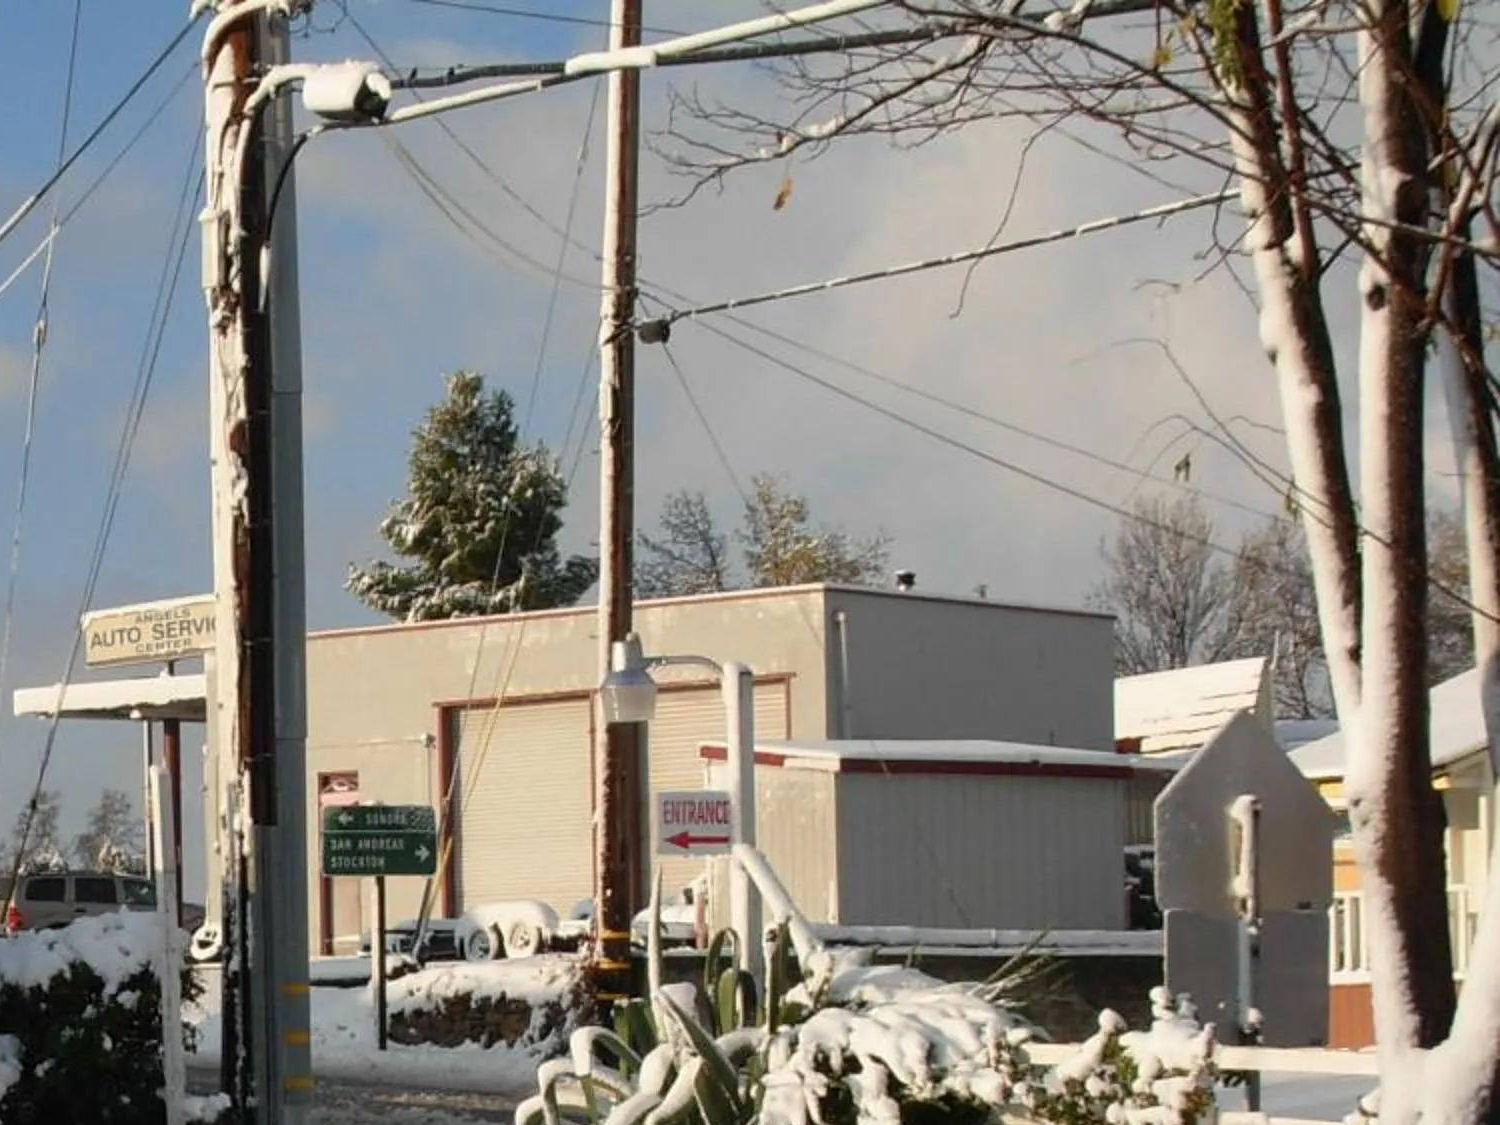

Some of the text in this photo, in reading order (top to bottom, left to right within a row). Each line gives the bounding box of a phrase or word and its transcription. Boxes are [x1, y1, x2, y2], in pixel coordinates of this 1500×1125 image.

[134, 607, 191, 624] ANGELS
[91, 627, 141, 650] AUTO
[663, 799, 731, 824] ENTRANCE
[330, 839, 405, 850] SAN ANDREAS
[330, 857, 385, 869] STOCKTON
